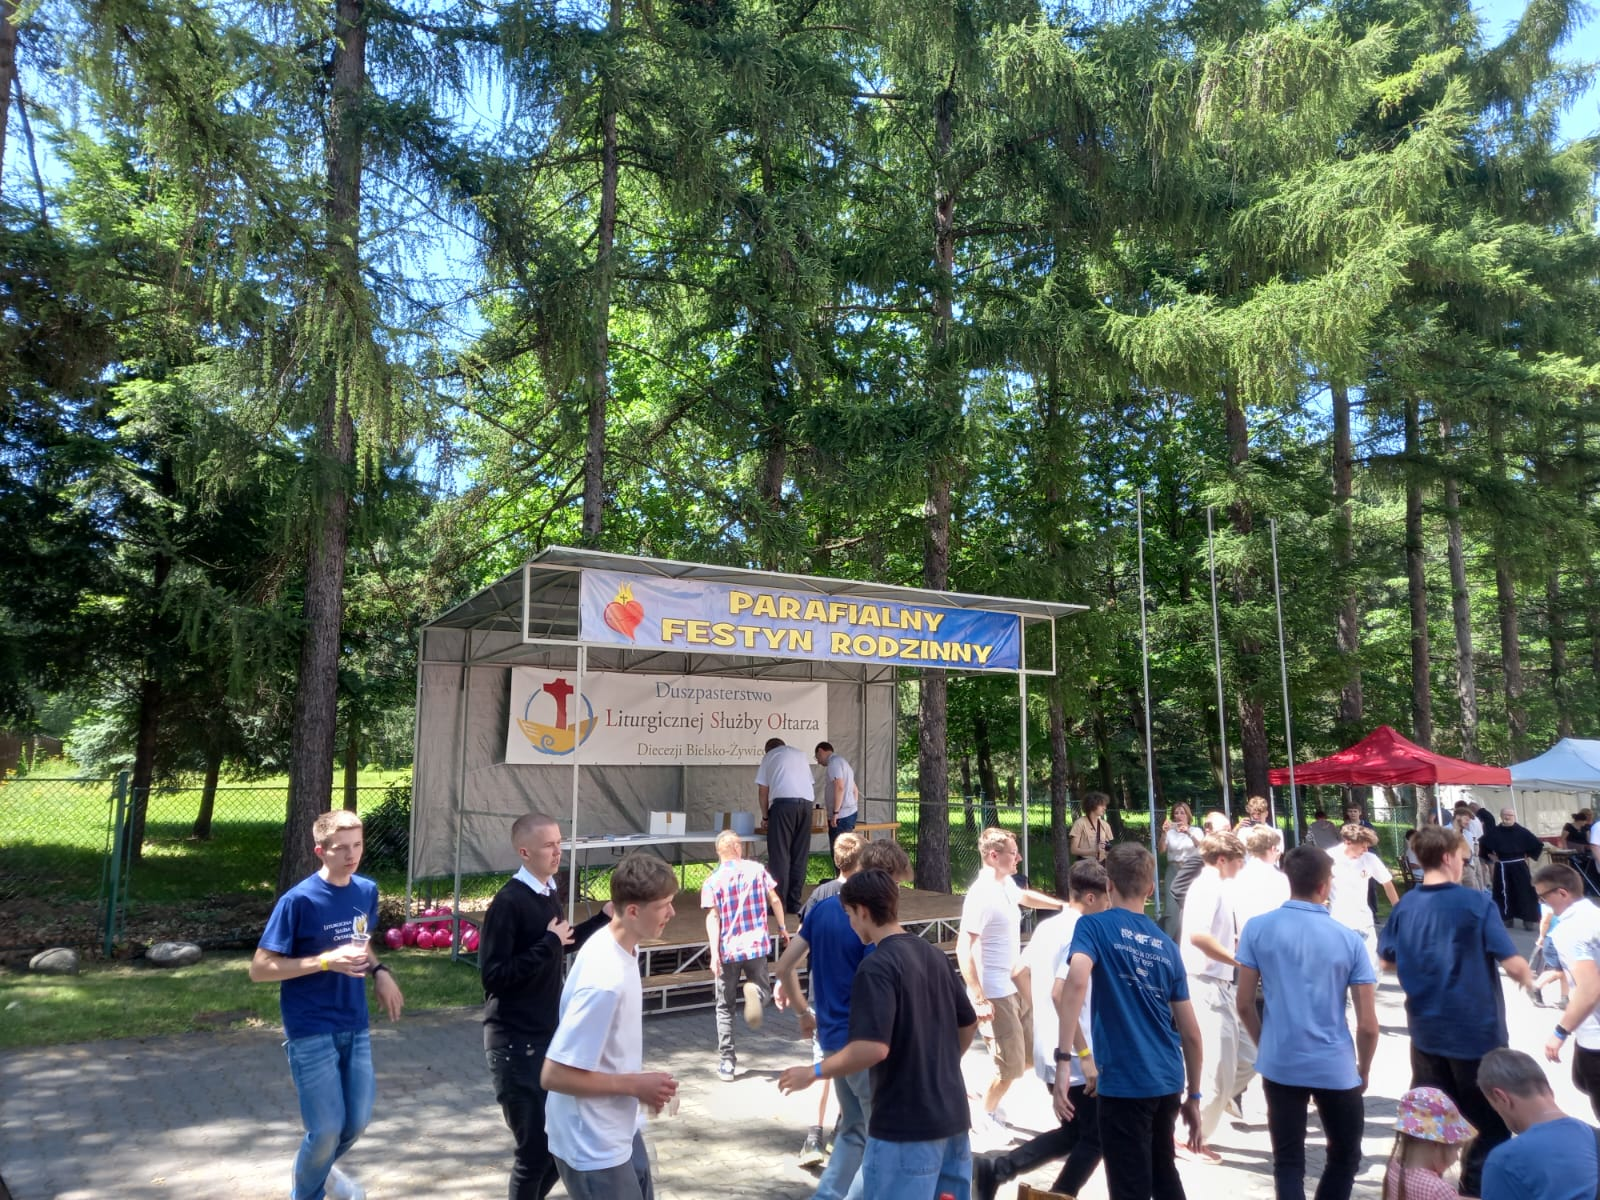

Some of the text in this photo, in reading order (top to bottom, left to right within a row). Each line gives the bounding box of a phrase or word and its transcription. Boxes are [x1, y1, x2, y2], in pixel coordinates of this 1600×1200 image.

[729, 590, 945, 633] PARAFIALNY
[661, 618, 993, 665] FESTYN RODZINNY
[655, 681, 772, 704] Duszpasterstwo
[605, 709, 820, 734] Liturgicznej Służby Ołtarza
[637, 741, 766, 759] Diecezji Bielsko-Żywiec
